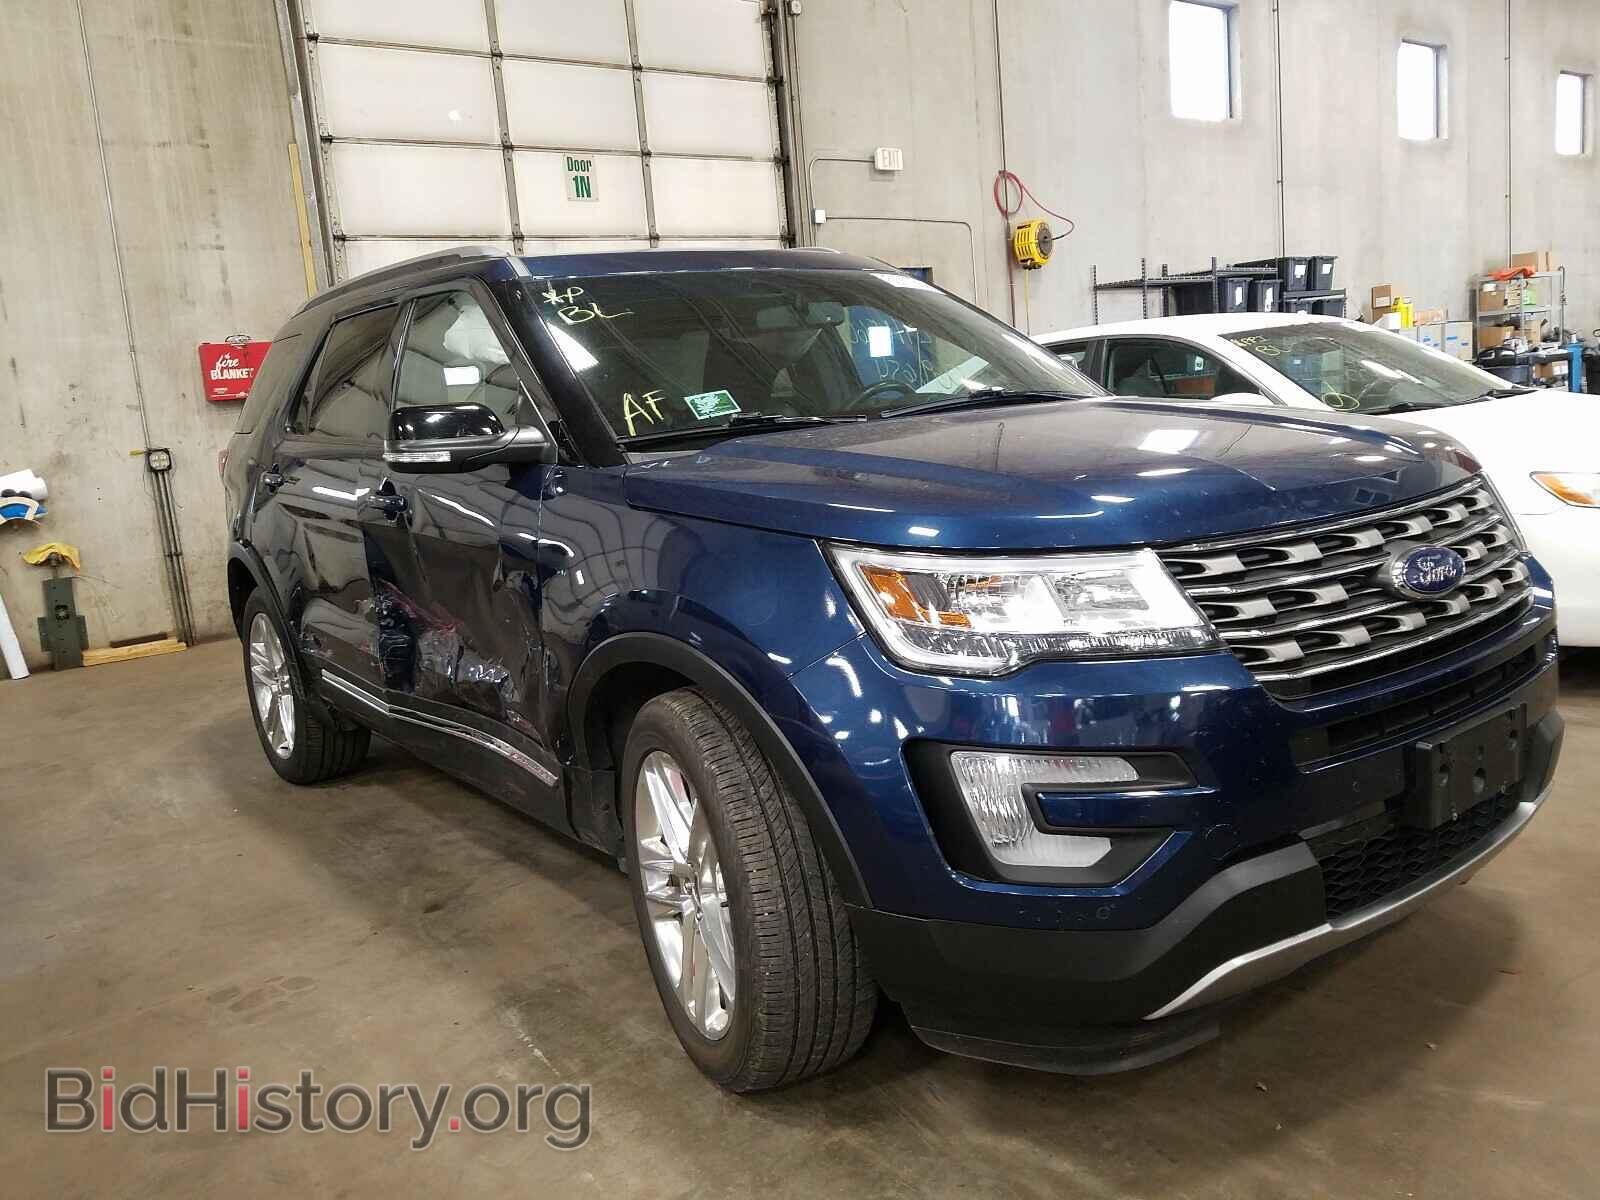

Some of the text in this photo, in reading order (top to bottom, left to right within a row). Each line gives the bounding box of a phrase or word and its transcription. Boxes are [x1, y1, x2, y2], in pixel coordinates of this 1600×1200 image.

[566, 156, 592, 172] Door
[881, 149, 900, 168] EXIT
[572, 175, 592, 198] 1N
[623, 389, 667, 437] AF
[1416, 556, 1457, 585] Ford
